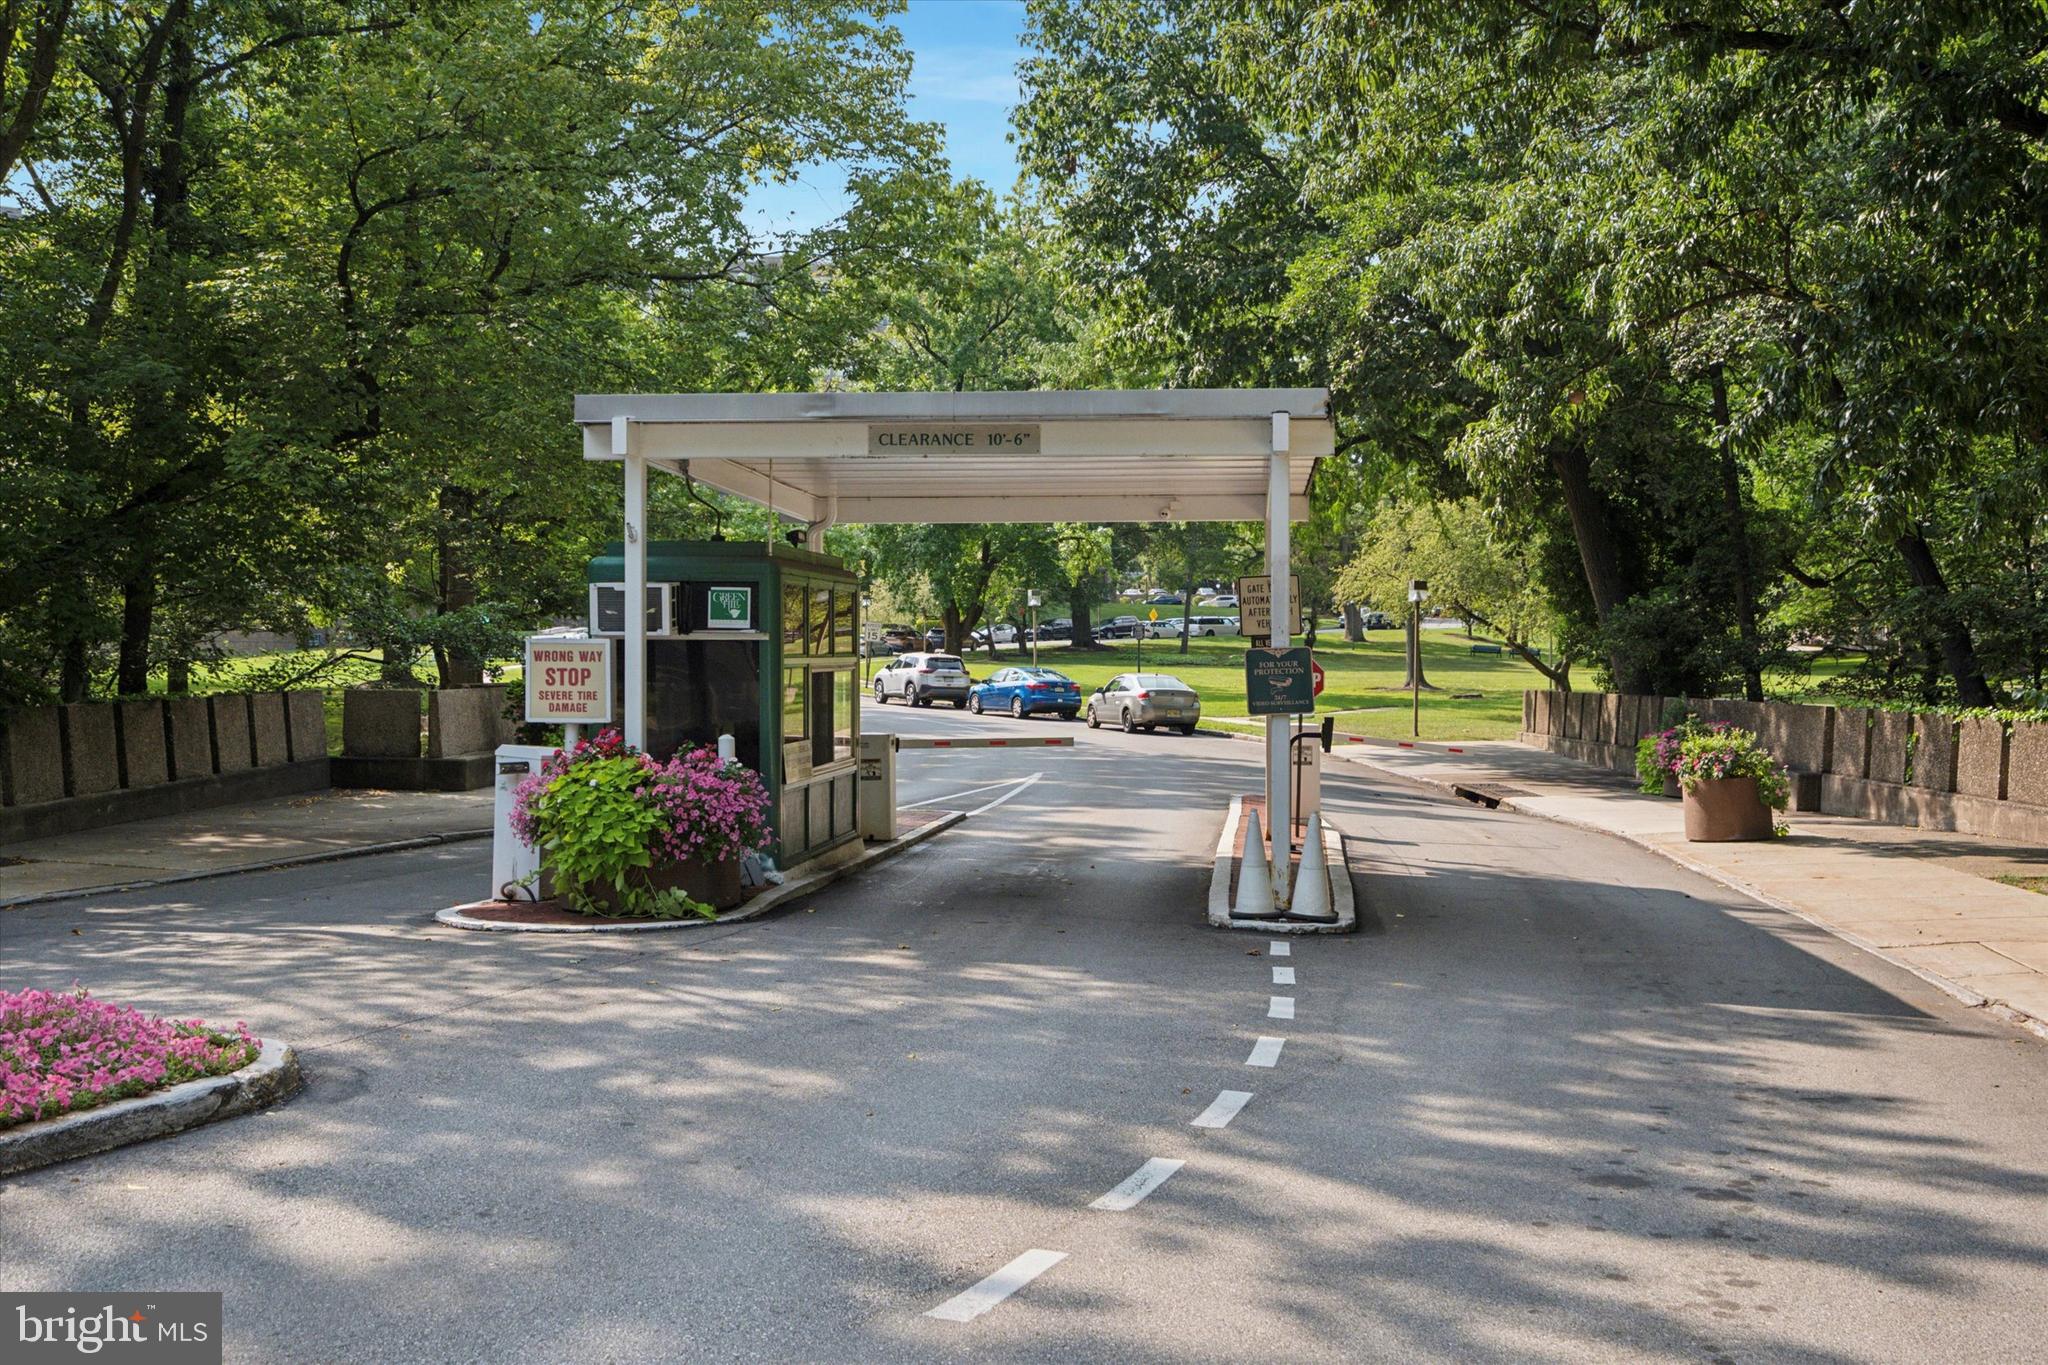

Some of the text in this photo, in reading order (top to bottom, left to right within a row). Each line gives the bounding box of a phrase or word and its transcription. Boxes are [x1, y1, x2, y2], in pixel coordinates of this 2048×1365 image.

[878, 433, 974, 446] CLEARANCE
[1247, 584, 1265, 593] GATE
[712, 592, 746, 602] GREEN
[867, 631, 878, 641] 15
[534, 650, 603, 662] WRONG WAY
[1276, 660, 1299, 668] YOUR
[1254, 667, 1304, 675] PROTECTION
[545, 667, 592, 687] STOP
[538, 690, 598, 701] SEVERE TIRE
[548, 702, 588, 713] DAMAGE
